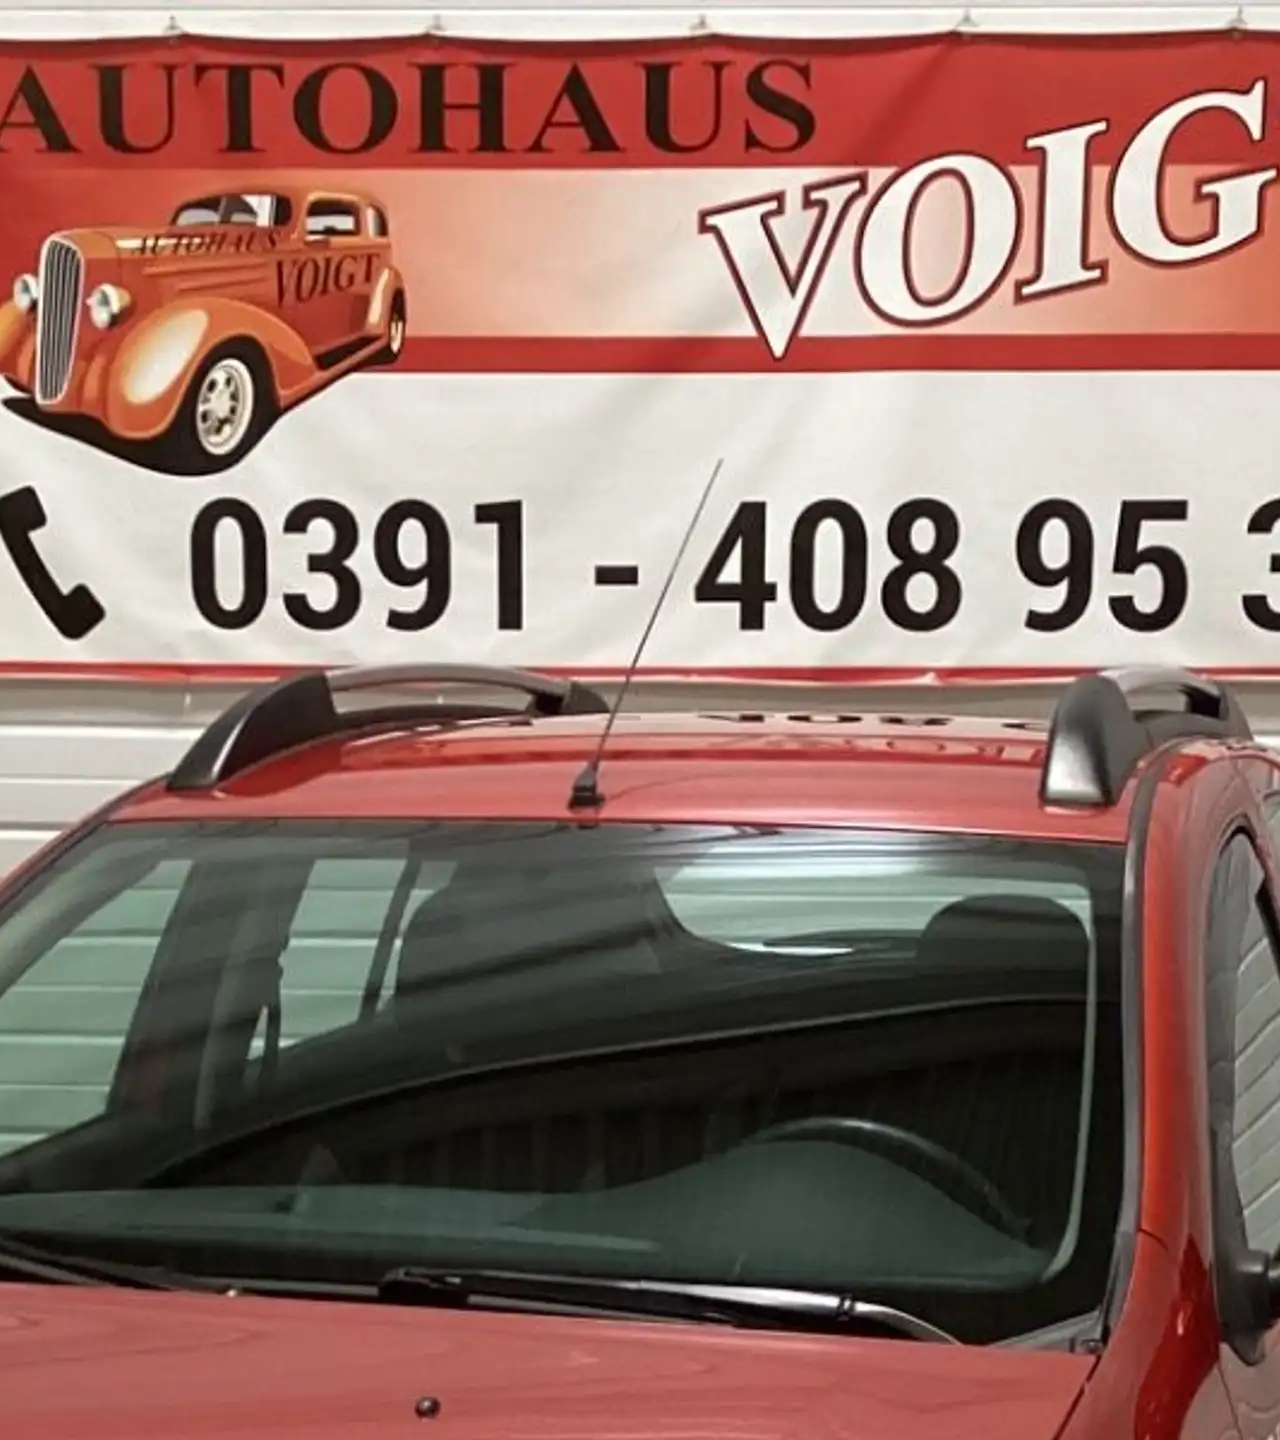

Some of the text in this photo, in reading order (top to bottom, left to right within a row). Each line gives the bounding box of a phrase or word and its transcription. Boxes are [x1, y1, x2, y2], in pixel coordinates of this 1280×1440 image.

[130, 230, 282, 254] AUTOHAUS
[274, 252, 380, 306] VOIGT
[190, 497, 528, 632] 0391
[694, 497, 962, 632] 408
[1015, 497, 1188, 632] 95
